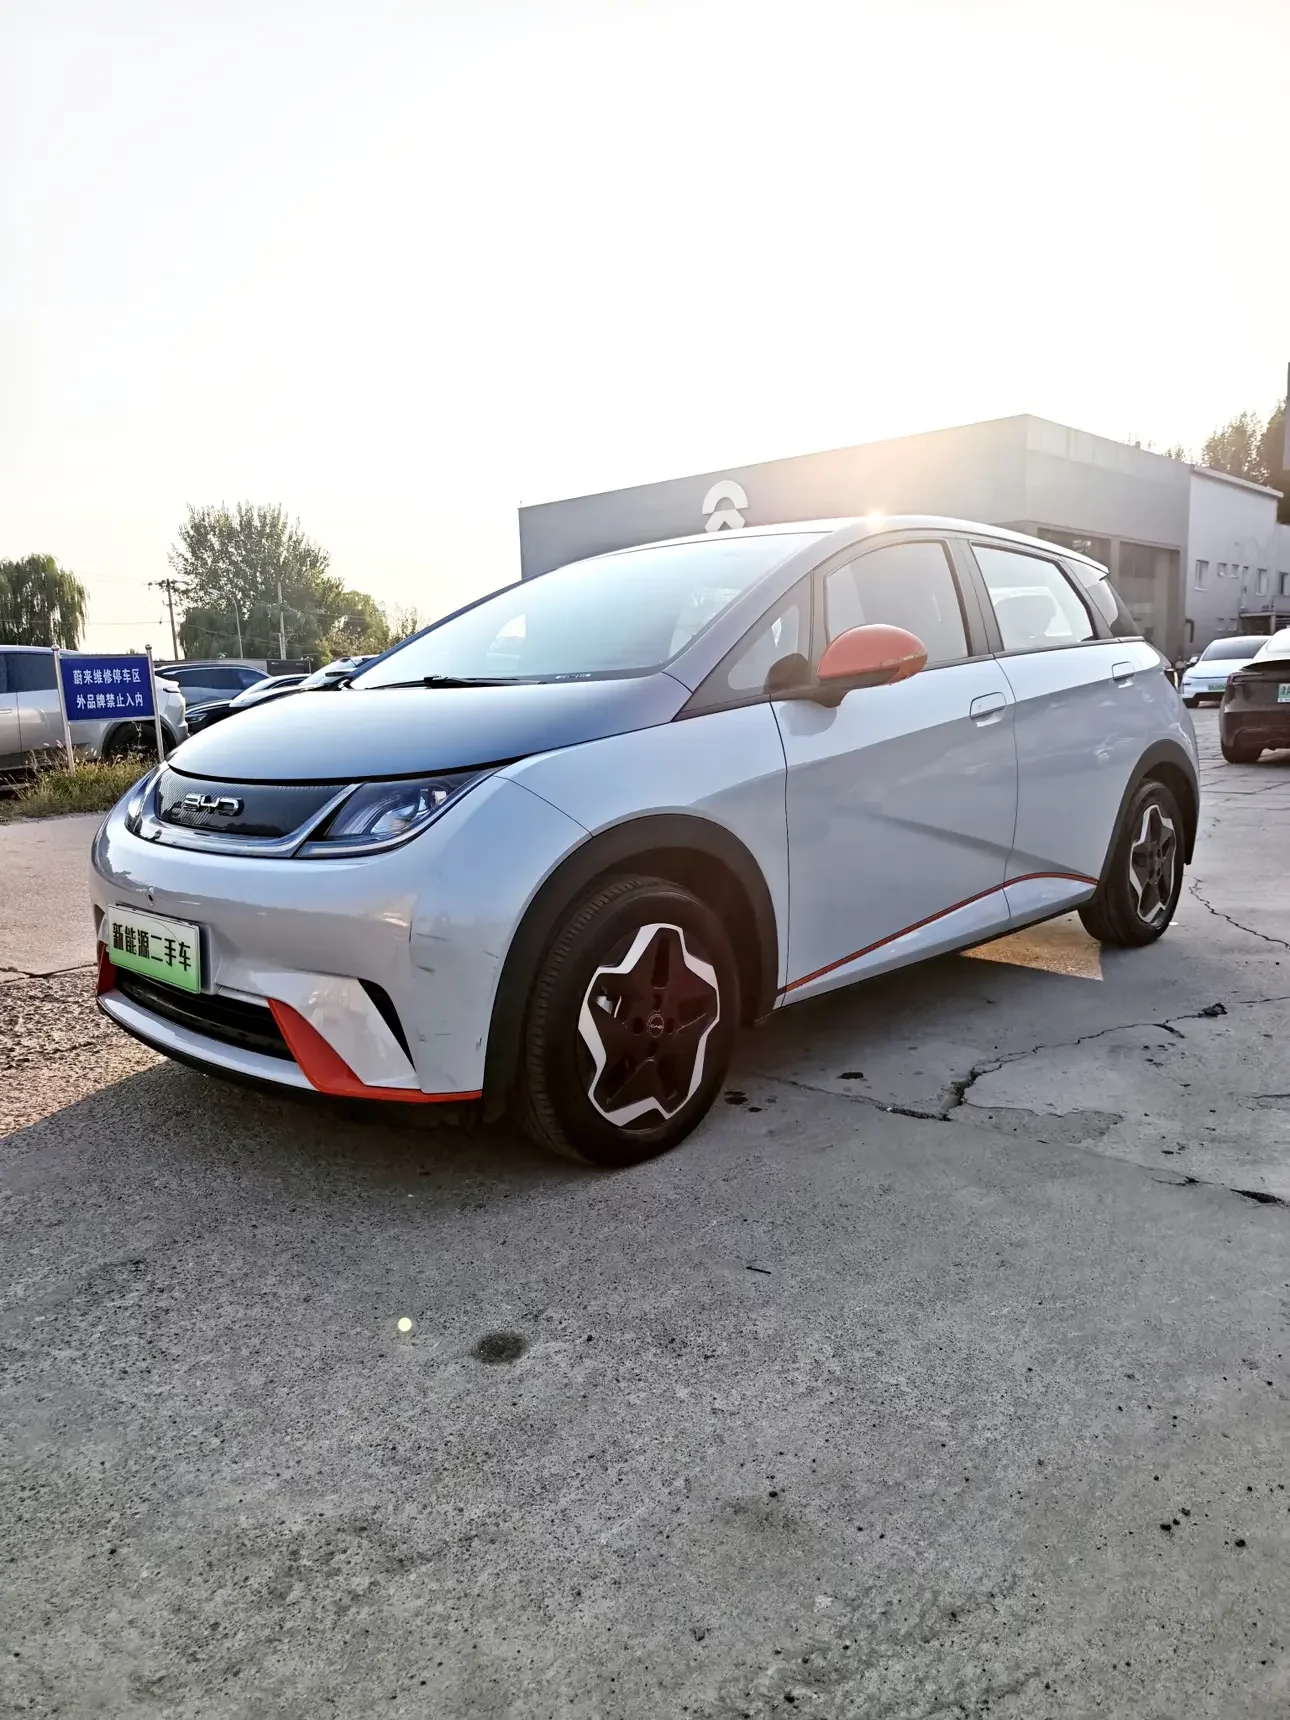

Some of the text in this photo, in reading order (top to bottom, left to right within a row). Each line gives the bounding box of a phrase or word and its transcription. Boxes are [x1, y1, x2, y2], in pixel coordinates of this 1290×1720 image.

[72, 668, 141, 685] 蔚来维修停车区
[76, 691, 144, 710] 外品牌禁止入内
[183, 793, 244, 816] BYD
[112, 922, 191, 971] 新能源二手车
